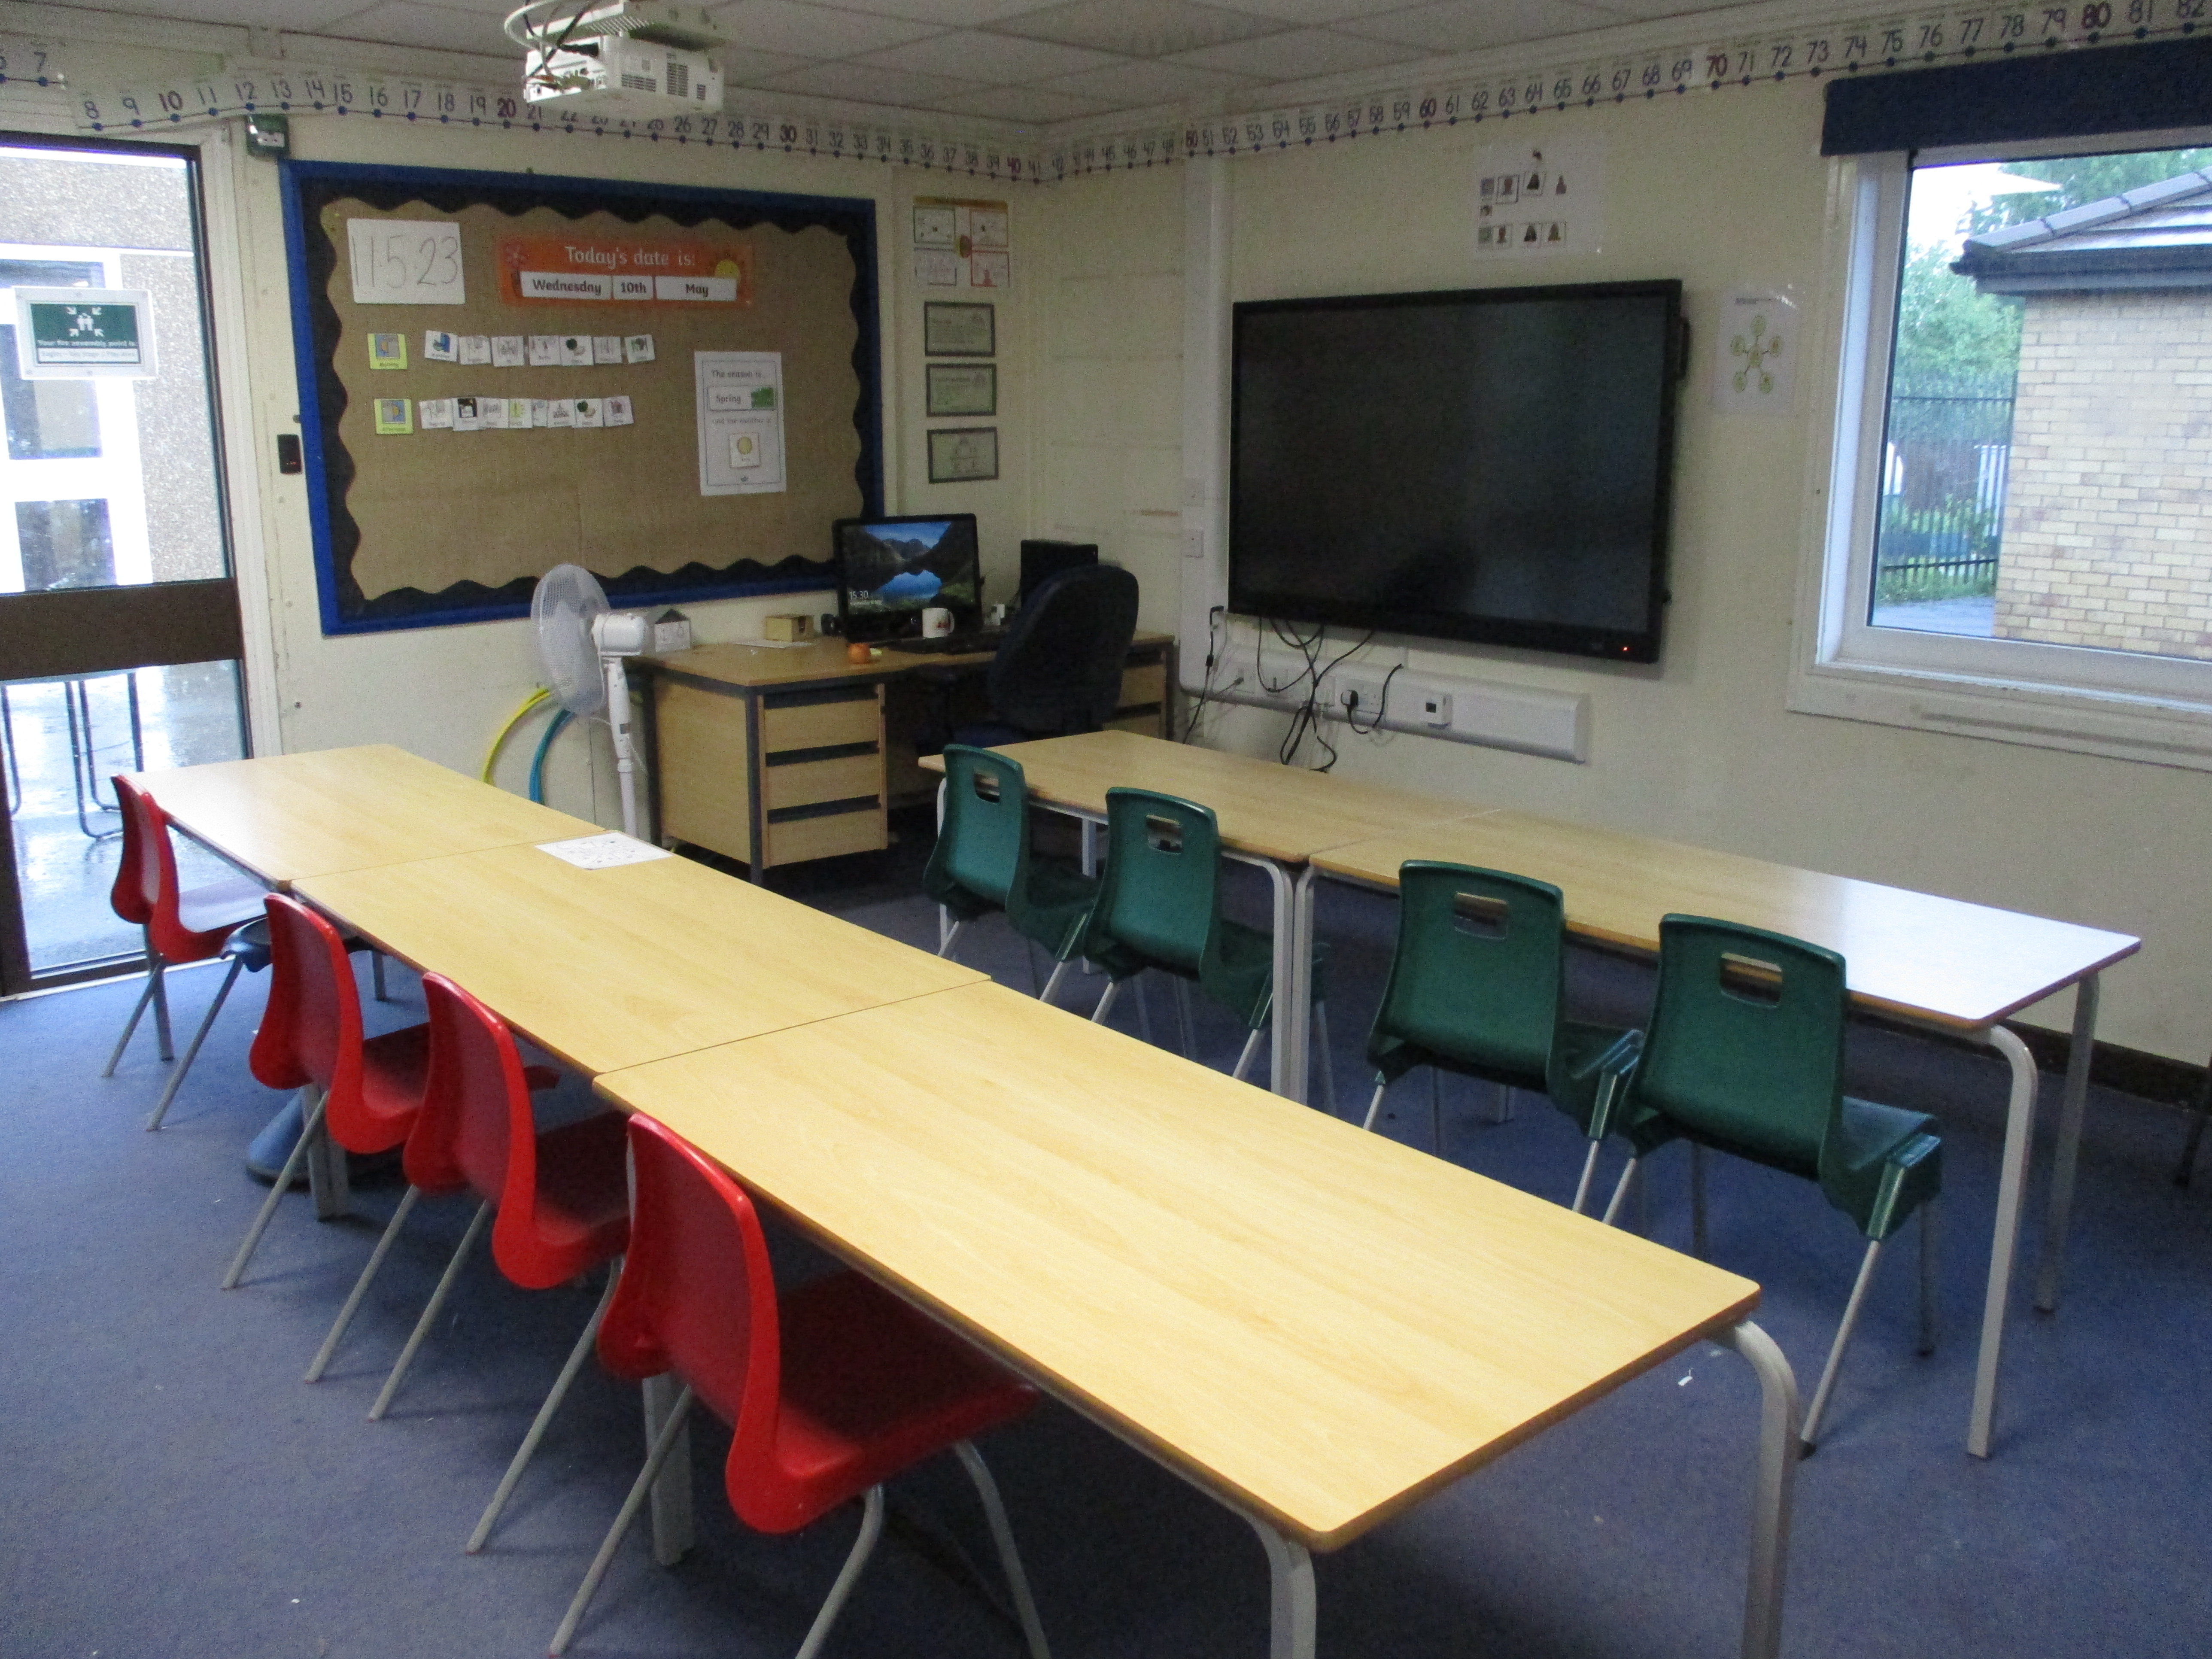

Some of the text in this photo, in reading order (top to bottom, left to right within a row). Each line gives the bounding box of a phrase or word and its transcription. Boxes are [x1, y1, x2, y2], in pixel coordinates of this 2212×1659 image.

[34, 51, 46, 72] 7
[1246, 123, 1264, 141] 53
[1273, 120, 1290, 139] 54
[1299, 116, 1316, 135] 55
[1325, 112, 1340, 132] 56
[1348, 108, 1361, 128] 57
[1394, 101, 1411, 122] 59
[1419, 97, 1437, 118] 60
[1446, 95, 1460, 115] 61
[1471, 90, 1489, 111] 62
[1499, 87, 1516, 107] 63
[1525, 82, 1543, 104] 64
[1553, 77, 1572, 99] 65
[1582, 74, 1601, 94] 66
[1612, 68, 1631, 91] 67
[1642, 64, 1661, 86] 68
[1671, 58, 1692, 82] 69
[1706, 52, 1728, 78] 70
[1738, 49, 1754, 73] 71
[1771, 45, 1793, 69] 72
[1807, 40, 1829, 64] 73
[1845, 34, 1867, 58] 74
[1881, 28, 1903, 55] 75
[1920, 24, 1944, 49] 76
[1961, 18, 1984, 44] 77
[2000, 14, 2025, 40] 78
[2042, 8, 2067, 34] 79
[2081, 3, 2112, 29] 80
[2128, 0, 2153, 24] 81
[85, 100, 99, 119] 8
[123, 97, 141, 115] 9
[158, 91, 183, 112] 10
[198, 86, 217, 105] 11
[235, 82, 256, 101] 12
[270, 79, 292, 99] 13
[305, 79, 325, 100] 14
[333, 83, 353, 104] 15
[370, 86, 388, 108] 16
[404, 89, 422, 109] 17
[438, 91, 456, 112] 18
[471, 94, 487, 115] 19
[497, 96, 516, 118] 20
[527, 103, 542, 120] 21
[675, 114, 692, 132] 26
[702, 115, 718, 135] 27
[728, 120, 744, 140] 28
[753, 122, 769, 141] 29
[780, 124, 797, 143] 30
[829, 131, 845, 149] 32
[876, 136, 891, 152] 34
[921, 142, 935, 160] 36
[1006, 156, 1021, 174] 40
[1143, 141, 1155, 156] 47
[565, 246, 628, 270] Today's
[634, 249, 668, 265] date
[532, 278, 709, 298] Wednesday 10th May
[716, 393, 741, 404] Spring
